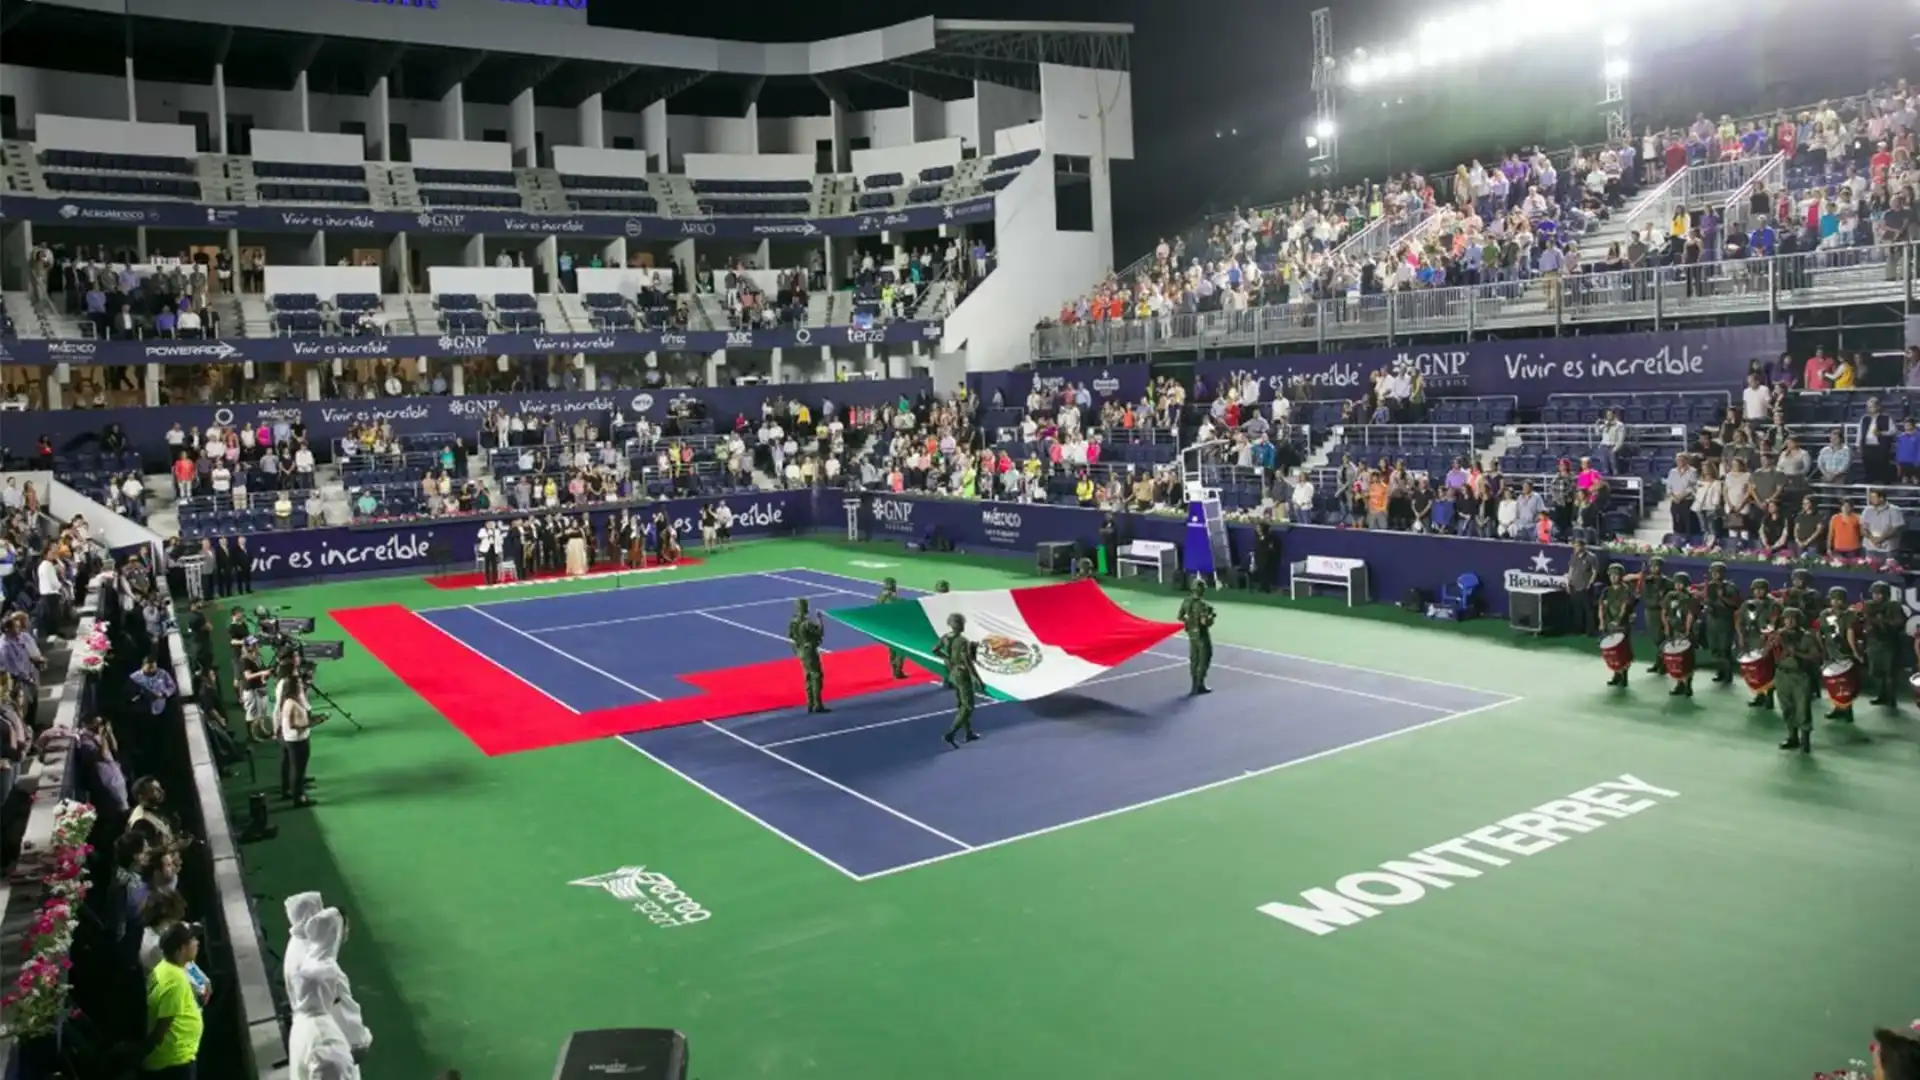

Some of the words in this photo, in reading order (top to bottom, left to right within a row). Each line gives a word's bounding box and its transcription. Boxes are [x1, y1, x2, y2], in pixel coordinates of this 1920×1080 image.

[432, 214, 464, 227] GNP
[454, 336, 487, 348] GNP
[1415, 352, 1466, 376] GNP
[1504, 353, 1556, 379] Vivir
[1563, 360, 1584, 377] es
[1591, 346, 1703, 378] increíble
[1269, 375, 1284, 390] es
[884, 500, 913, 521] GNP
[288, 551, 312, 569] es
[320, 534, 430, 566] increíble
[1255, 773, 1681, 936] MONTERREY
